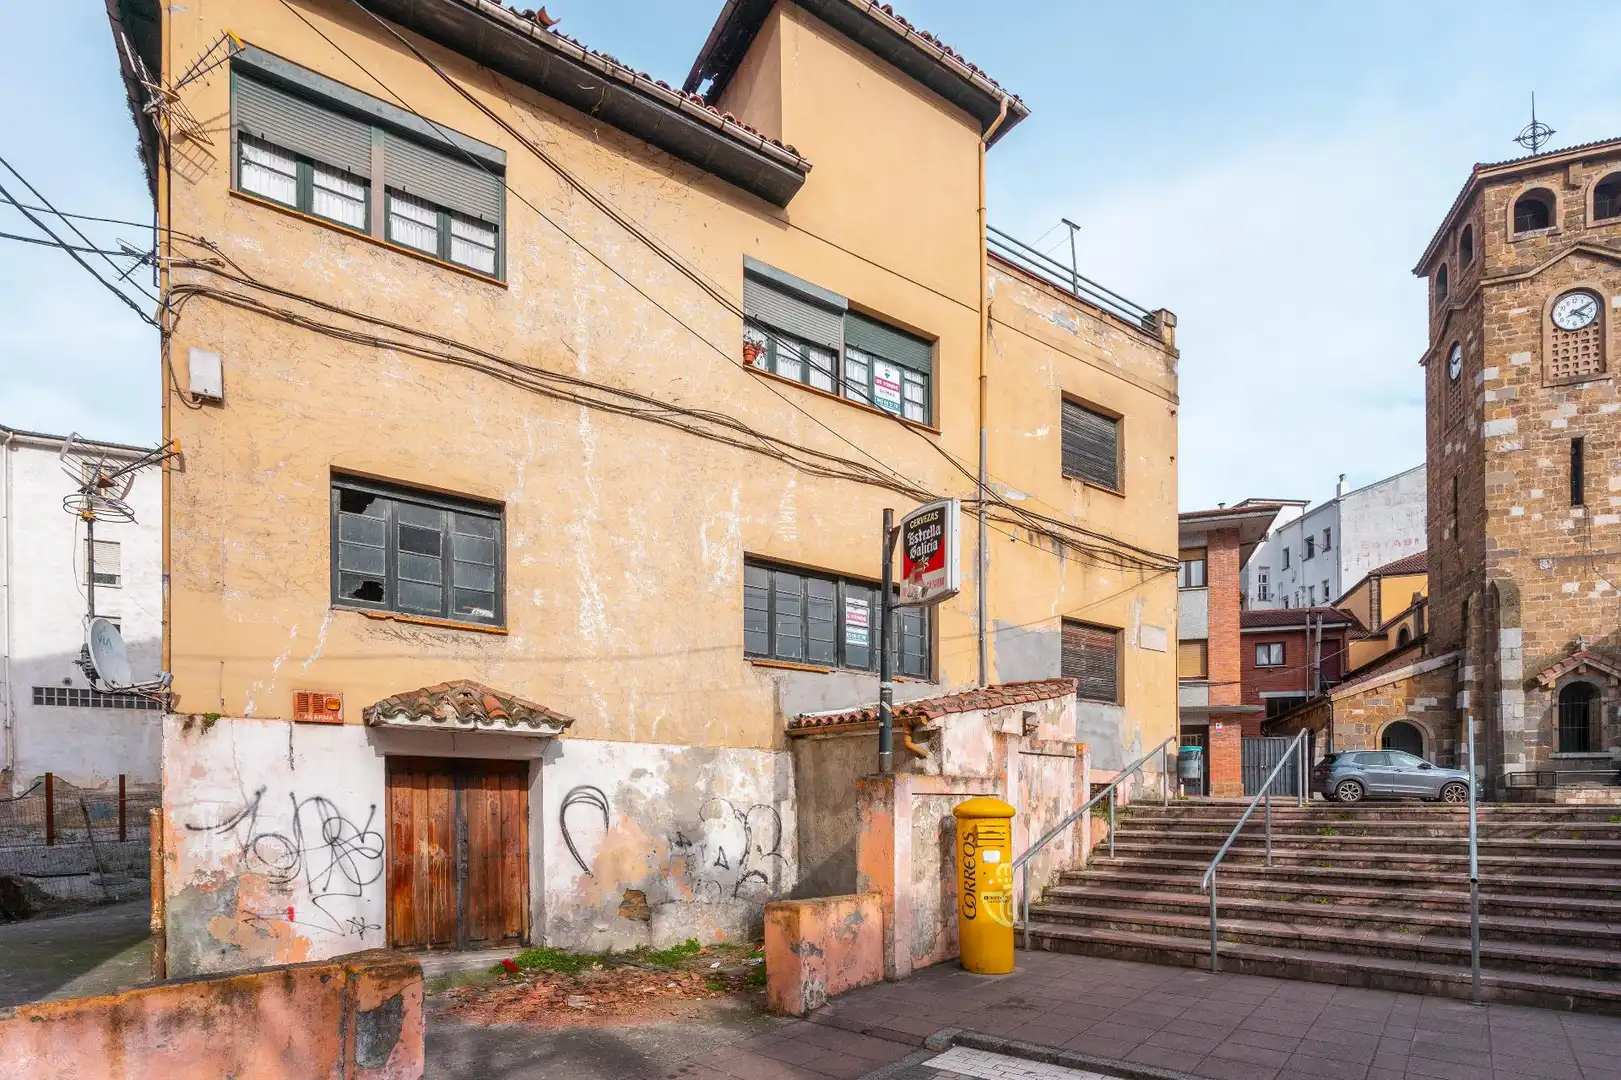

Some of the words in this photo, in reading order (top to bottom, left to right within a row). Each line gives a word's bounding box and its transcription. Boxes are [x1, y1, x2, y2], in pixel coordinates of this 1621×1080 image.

[909, 511, 939, 529] CERVEZAS
[907, 524, 941, 546] Estrella
[910, 540, 938, 560] Galicia
[961, 831, 977, 920] CORREOS
